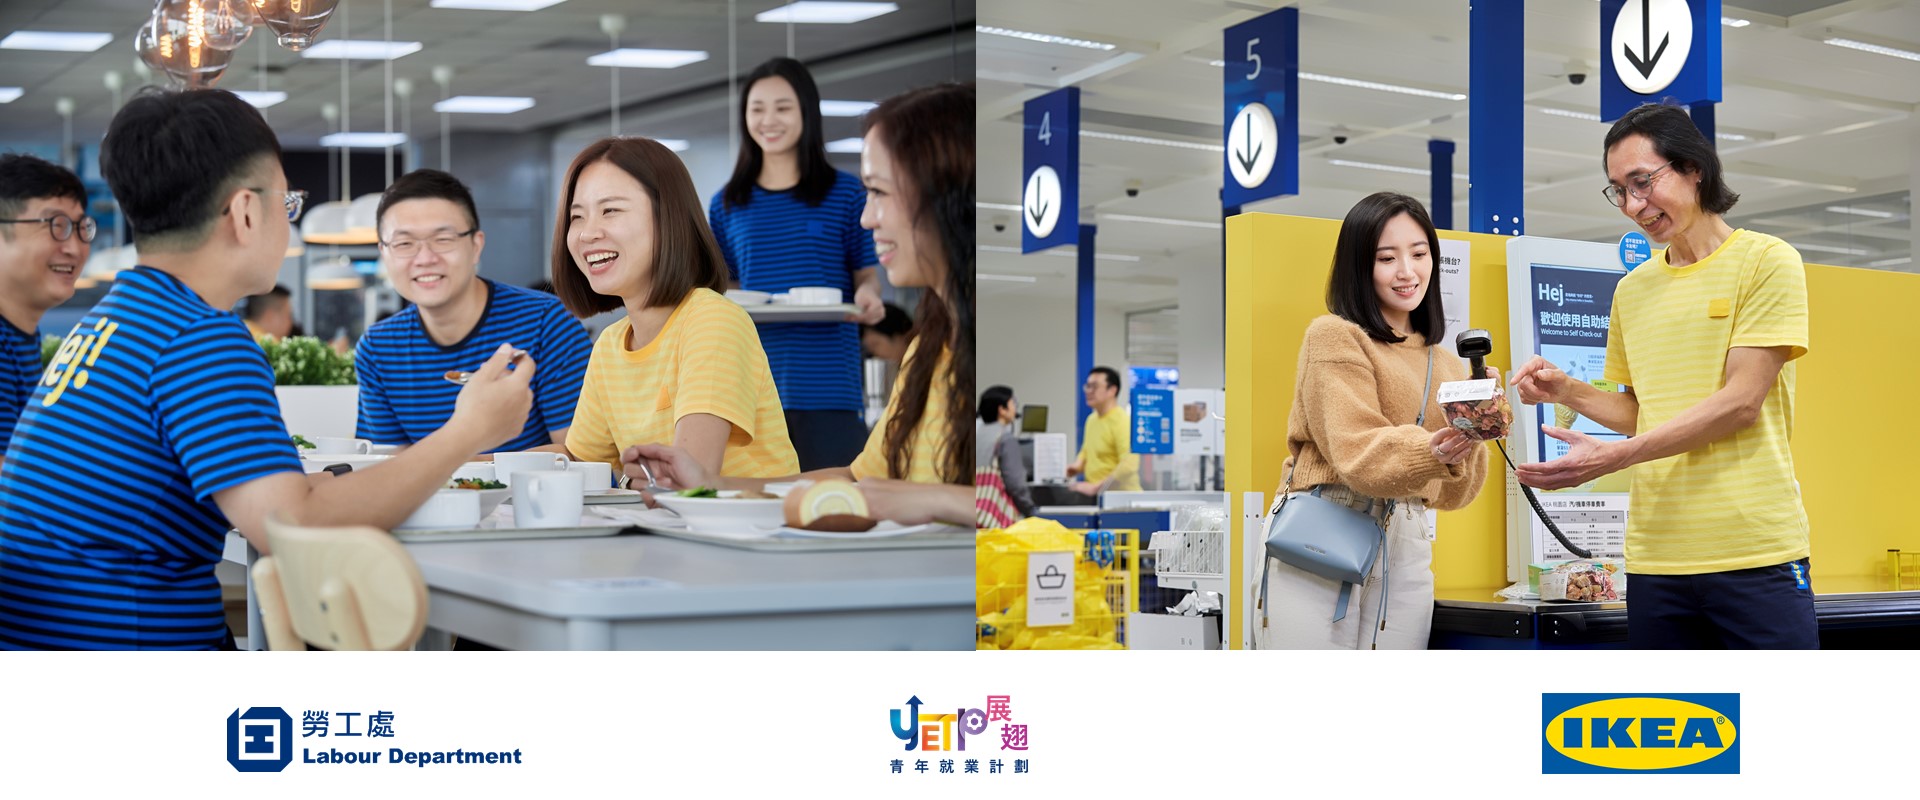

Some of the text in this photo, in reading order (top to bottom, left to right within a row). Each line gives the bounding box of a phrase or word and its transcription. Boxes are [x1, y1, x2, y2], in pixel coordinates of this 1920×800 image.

[1246, 38, 1262, 80] 5
[1038, 111, 1052, 146] 4
[1538, 283, 1564, 307] Hej
[1540, 311, 1610, 329] 歡迎使用自助結
[1540, 328, 1563, 336] Welcome
